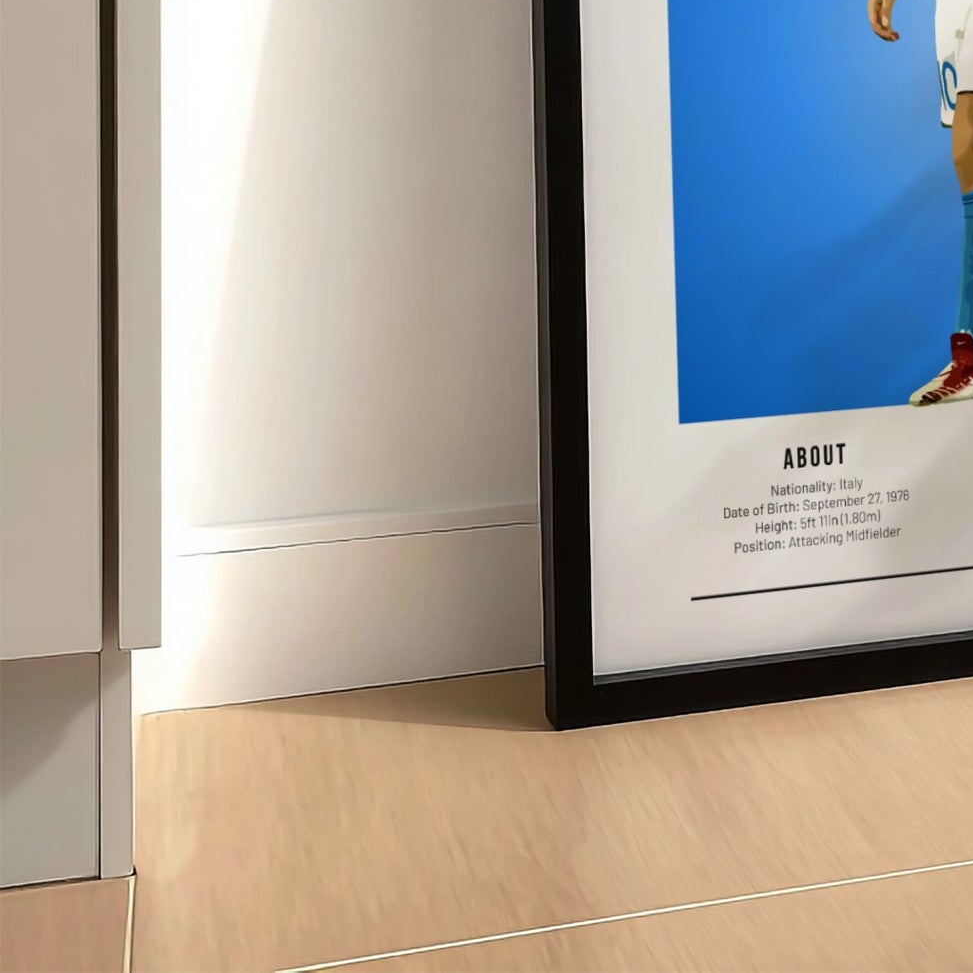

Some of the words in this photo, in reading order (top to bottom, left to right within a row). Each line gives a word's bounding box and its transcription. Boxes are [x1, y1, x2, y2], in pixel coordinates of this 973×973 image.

[783, 443, 846, 470] ABOUT
[770, 481, 836, 497] Nationality:
[839, 477, 863, 492] Italy
[723, 505, 750, 519] Date
[752, 502, 765, 516] of
[767, 500, 800, 514] Birth:
[802, 495, 865, 513] September
[886, 489, 910, 503] 1976
[734, 538, 786, 554] Position:
[788, 531, 843, 549] Attacking
[846, 526, 901, 542] Midfielder
[755, 520, 797, 537] Height:
[800, 517, 816, 530] 5ft
